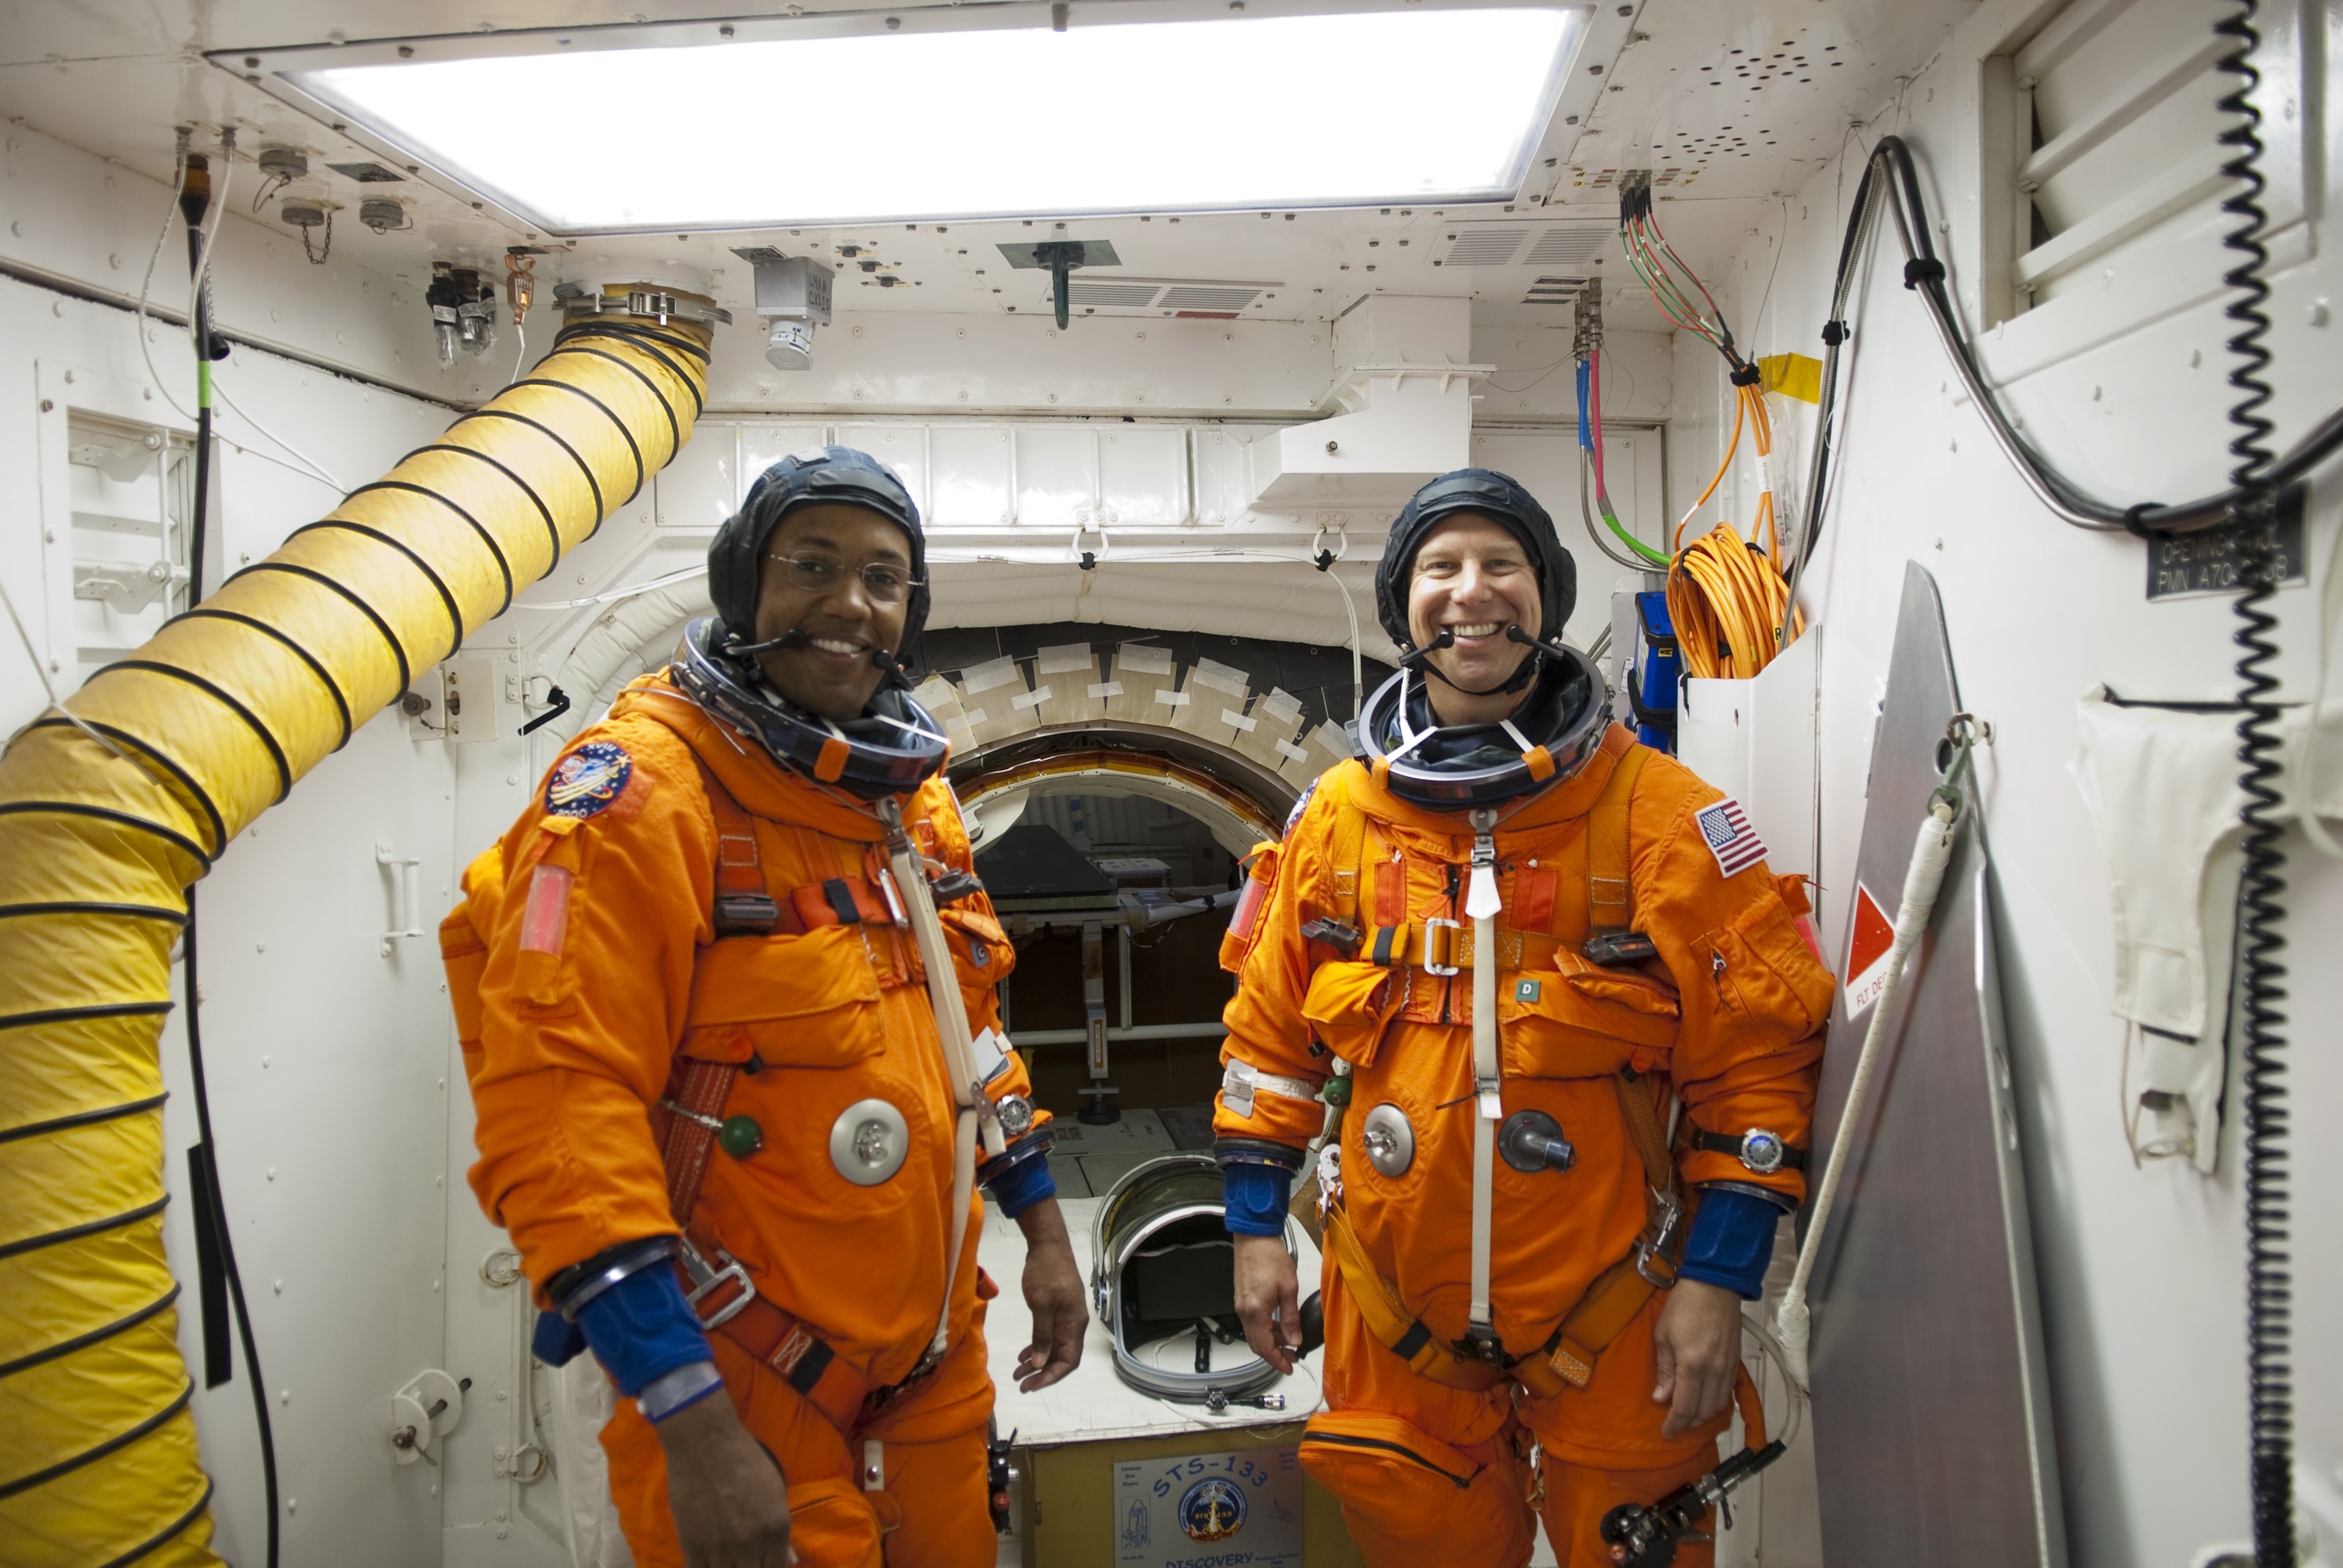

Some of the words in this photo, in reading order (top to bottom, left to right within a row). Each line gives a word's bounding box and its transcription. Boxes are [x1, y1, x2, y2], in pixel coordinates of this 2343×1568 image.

[2162, 533, 2226, 565] OPENING
[2158, 570, 2190, 593] PMN
[587, 742, 618, 753] XVIII
[1522, 983, 1532, 995] D
[1856, 987, 1869, 1008] FLT
[1154, 1456, 1268, 1498] STS-133
[1166, 1552, 1253, 1568] DISCOVERY
